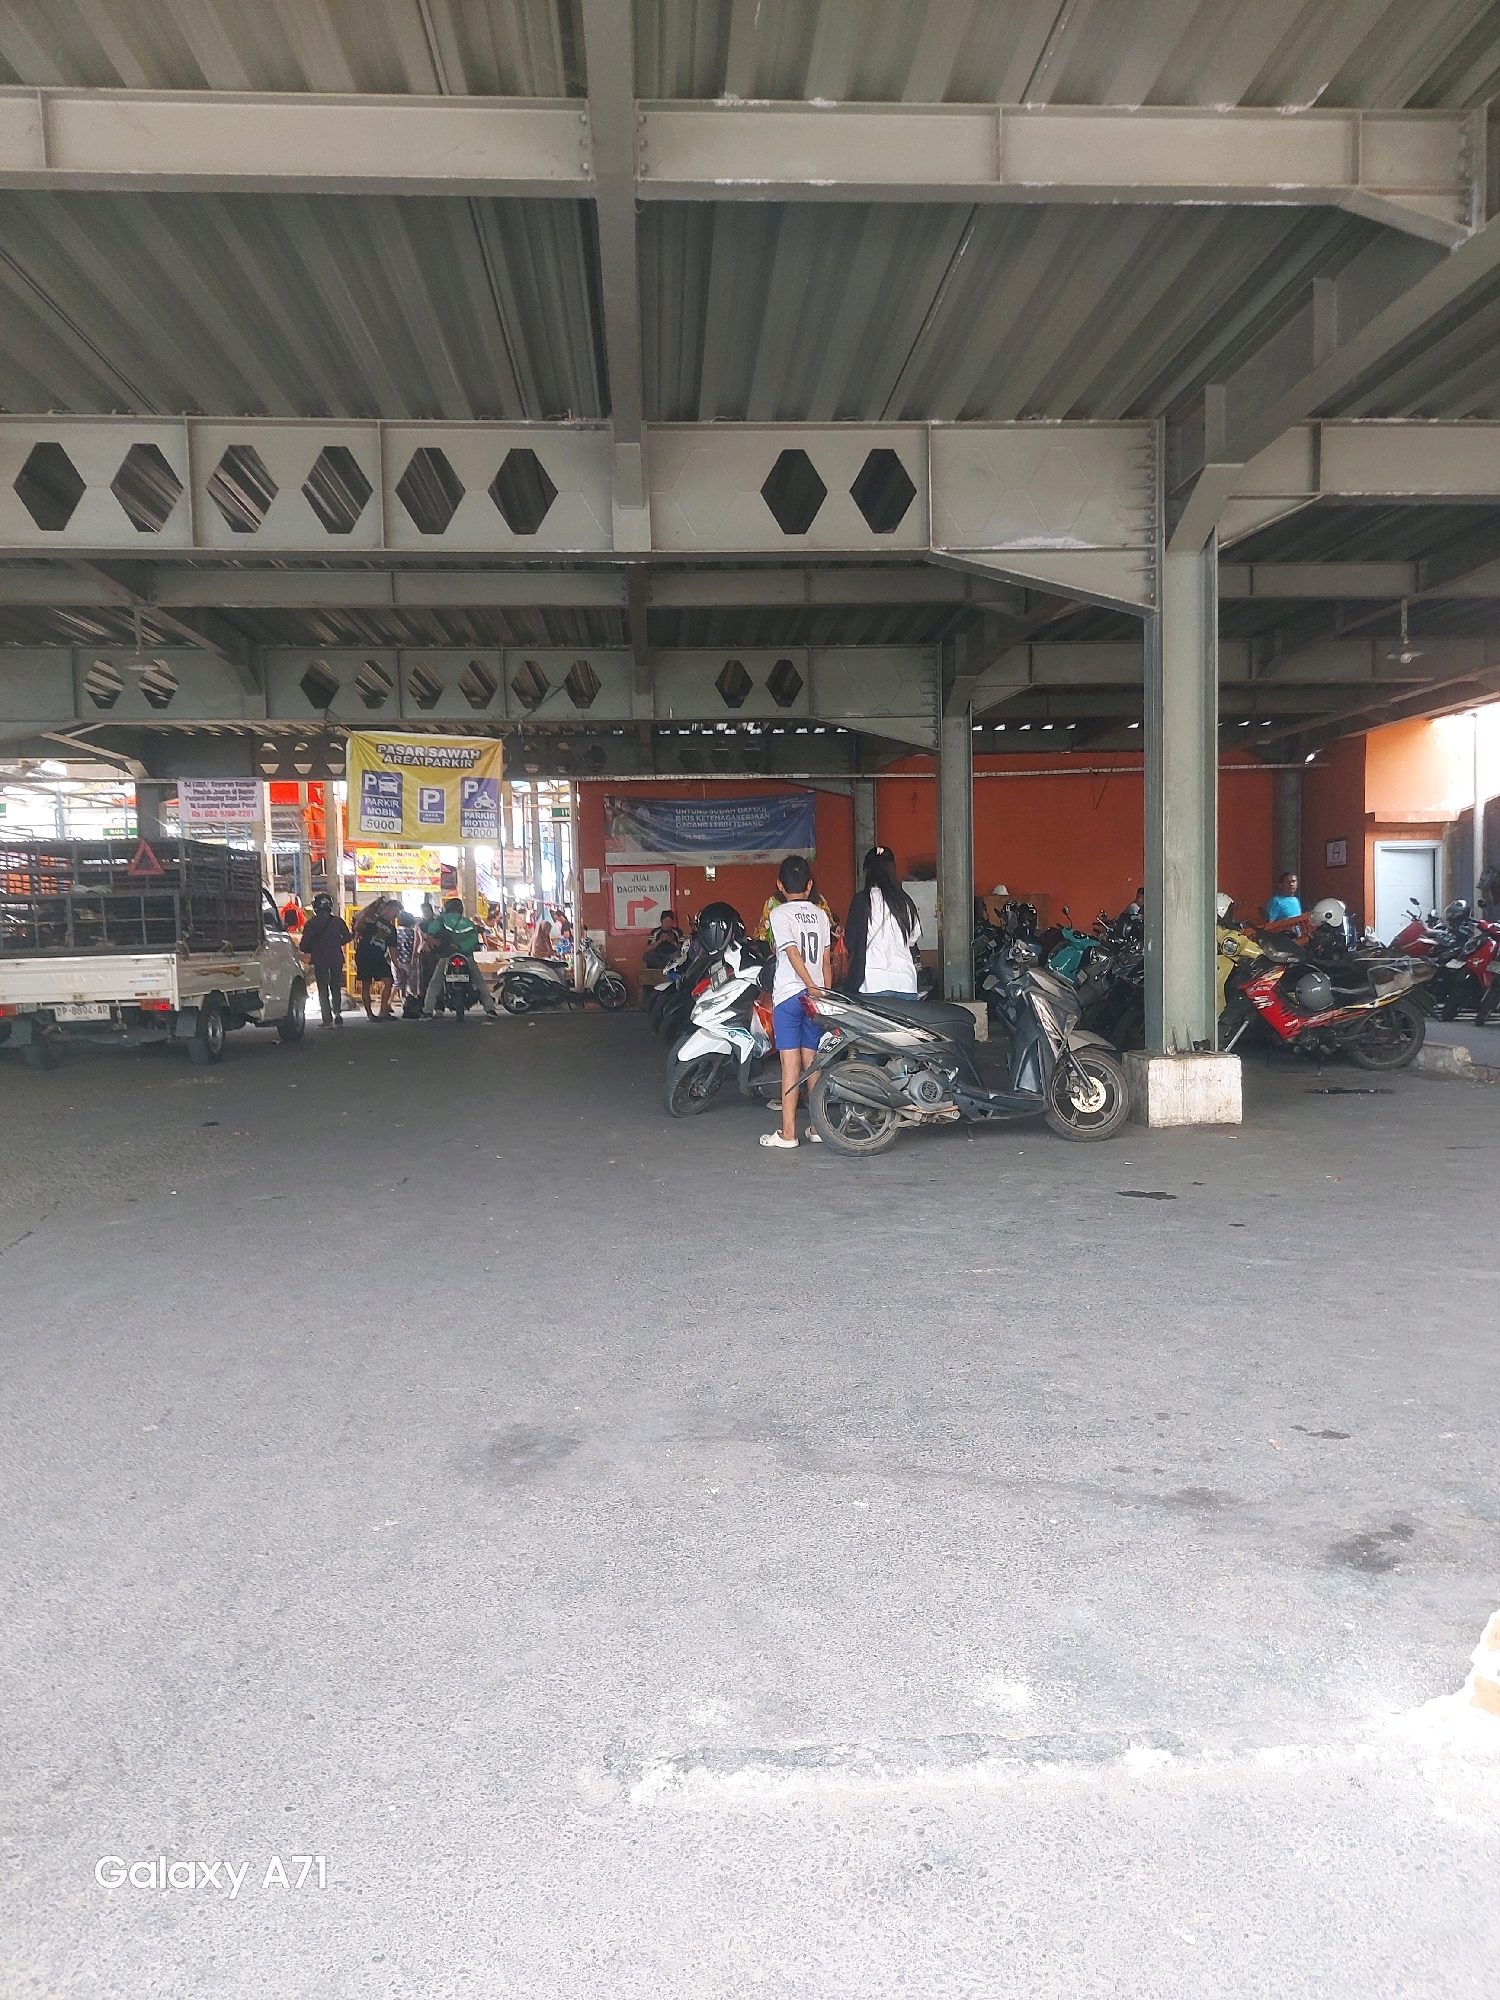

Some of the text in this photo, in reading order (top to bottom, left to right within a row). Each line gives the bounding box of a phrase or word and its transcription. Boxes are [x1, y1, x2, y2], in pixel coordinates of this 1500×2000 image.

[377, 744, 481, 759] PASAR SAWAH
[383, 754, 474, 768] AREA PARKIR
[364, 774, 377, 790] P
[464, 781, 478, 799] P
[364, 797, 399, 808] PARKIR
[423, 790, 441, 810] P
[367, 806, 397, 818] MOBIL
[464, 812, 496, 820] PARKIR
[709, 807, 736, 815] SUDAH
[696, 814, 771, 822] KETENAGAKERJAAN
[366, 820, 395, 830] 5000
[464, 820, 496, 828] MOTOR
[467, 829, 492, 837] 2000
[631, 874, 652, 883] JUAL
[616, 884, 668, 894] DAGING BABI
[800, 931, 819, 964] 10
